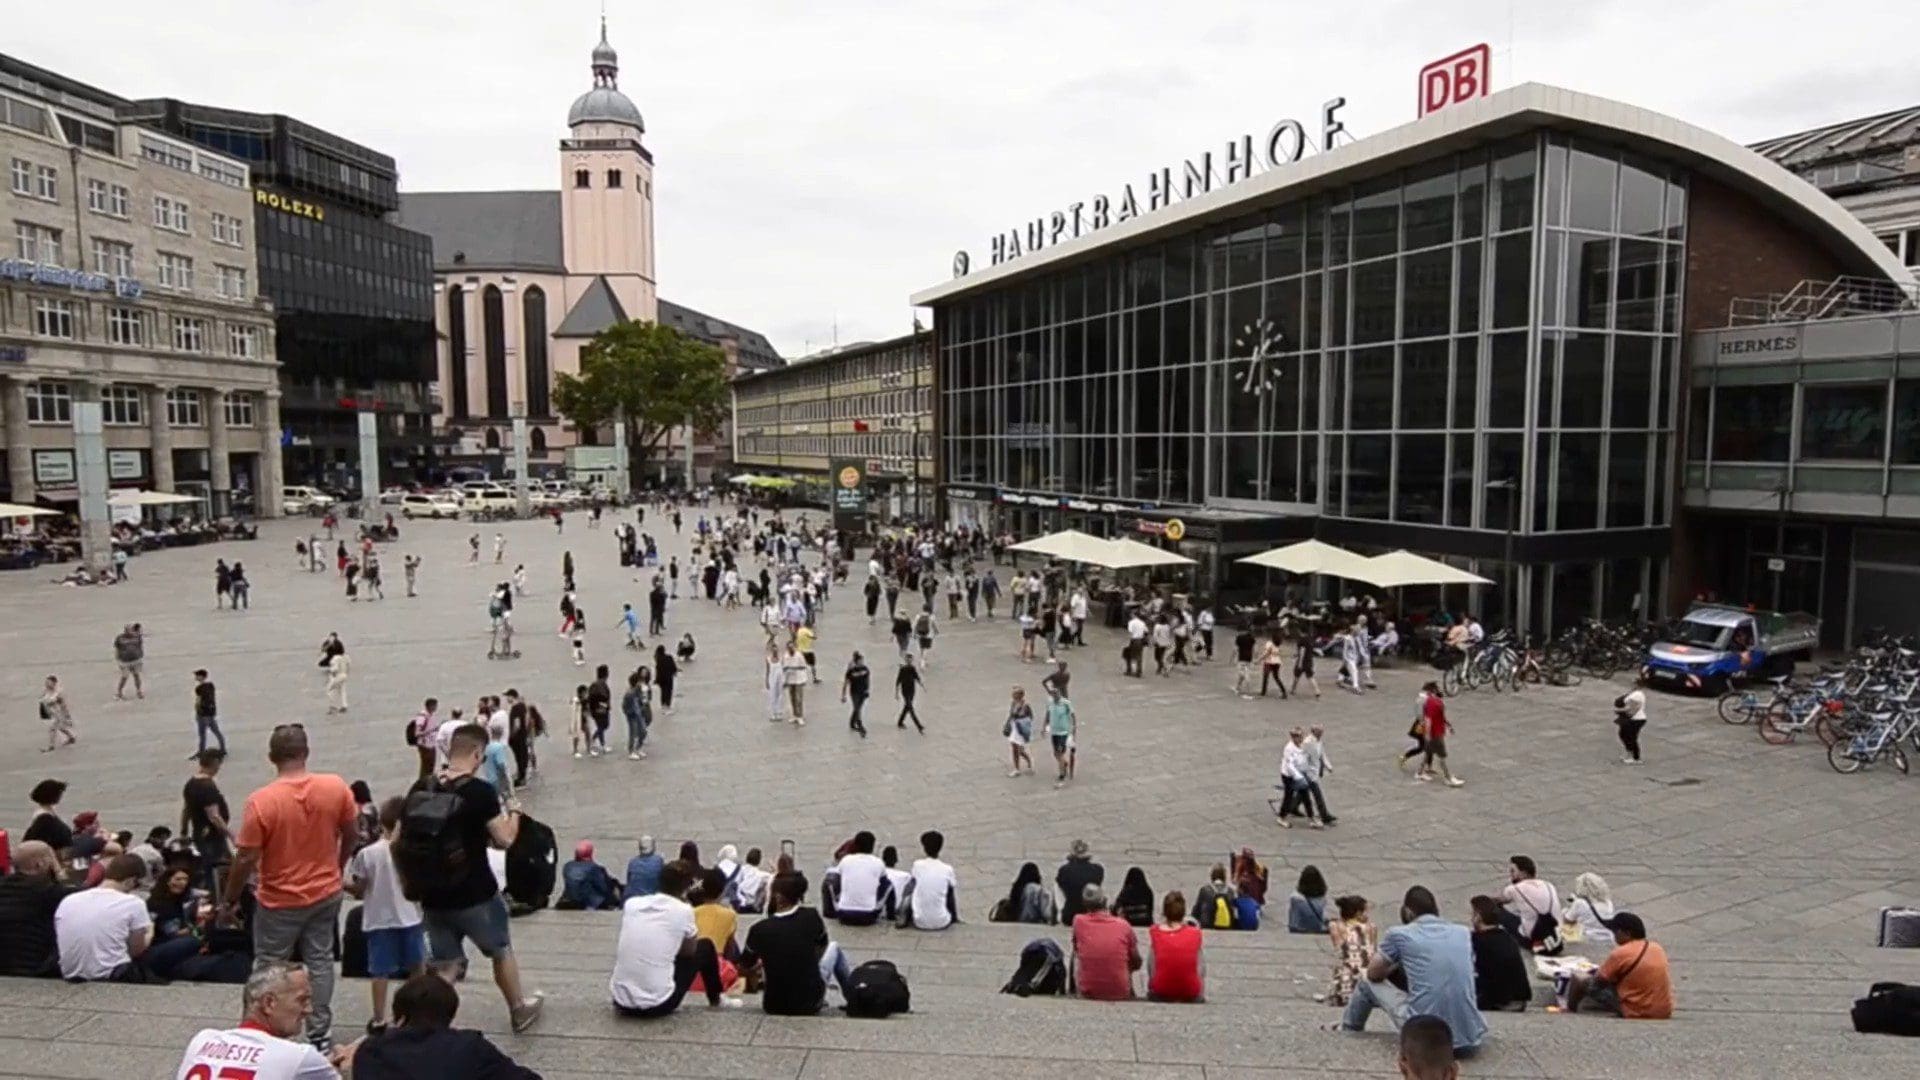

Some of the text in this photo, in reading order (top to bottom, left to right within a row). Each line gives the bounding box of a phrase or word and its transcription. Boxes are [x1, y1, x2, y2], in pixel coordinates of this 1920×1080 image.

[1426, 58, 1477, 114] DB
[991, 97, 1346, 267] HAUPTBAHNHOF
[256, 190, 315, 218] ROLEX
[196, 1041, 265, 1063] MODESTE
